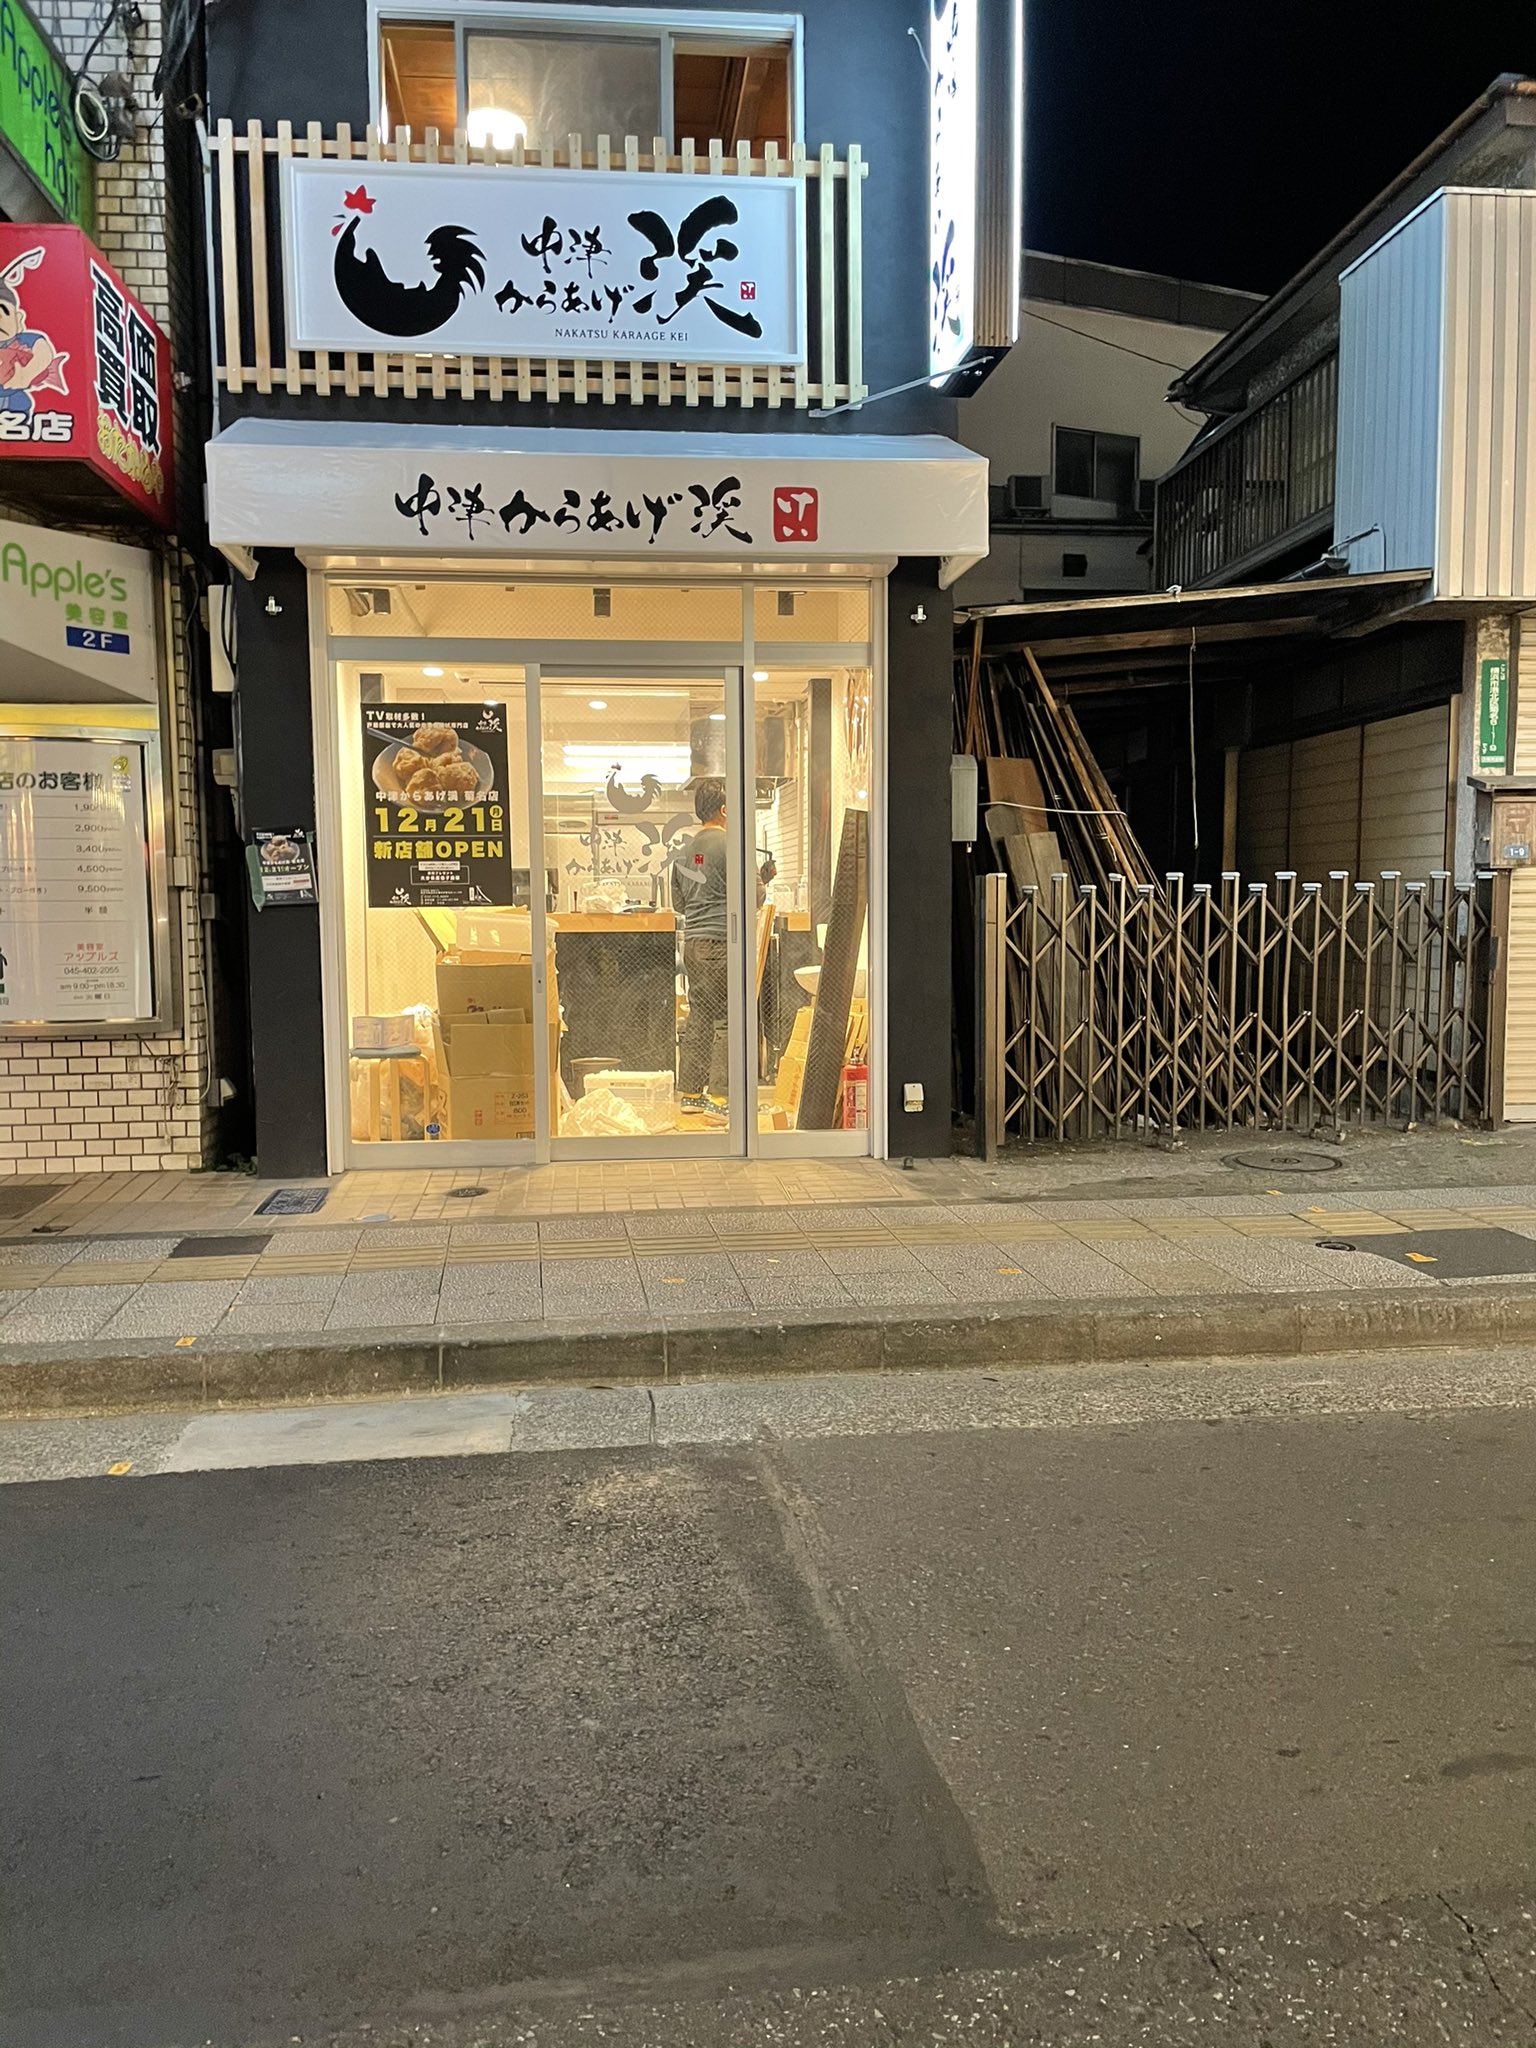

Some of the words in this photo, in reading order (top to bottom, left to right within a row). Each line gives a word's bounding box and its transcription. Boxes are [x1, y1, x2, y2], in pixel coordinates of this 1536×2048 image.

[521, 216, 612, 278] 中津
[494, 280, 634, 322] からあげ
[555, 328, 609, 339] NAKATSU
[613, 329, 667, 341] KARAAGE
[670, 331, 689, 341] KEI
[2, 543, 128, 602] Apple's
[66, 603, 129, 630] 美容室
[82, 631, 113, 649] 2F
[1510, 847, 1525, 857] 1-9
